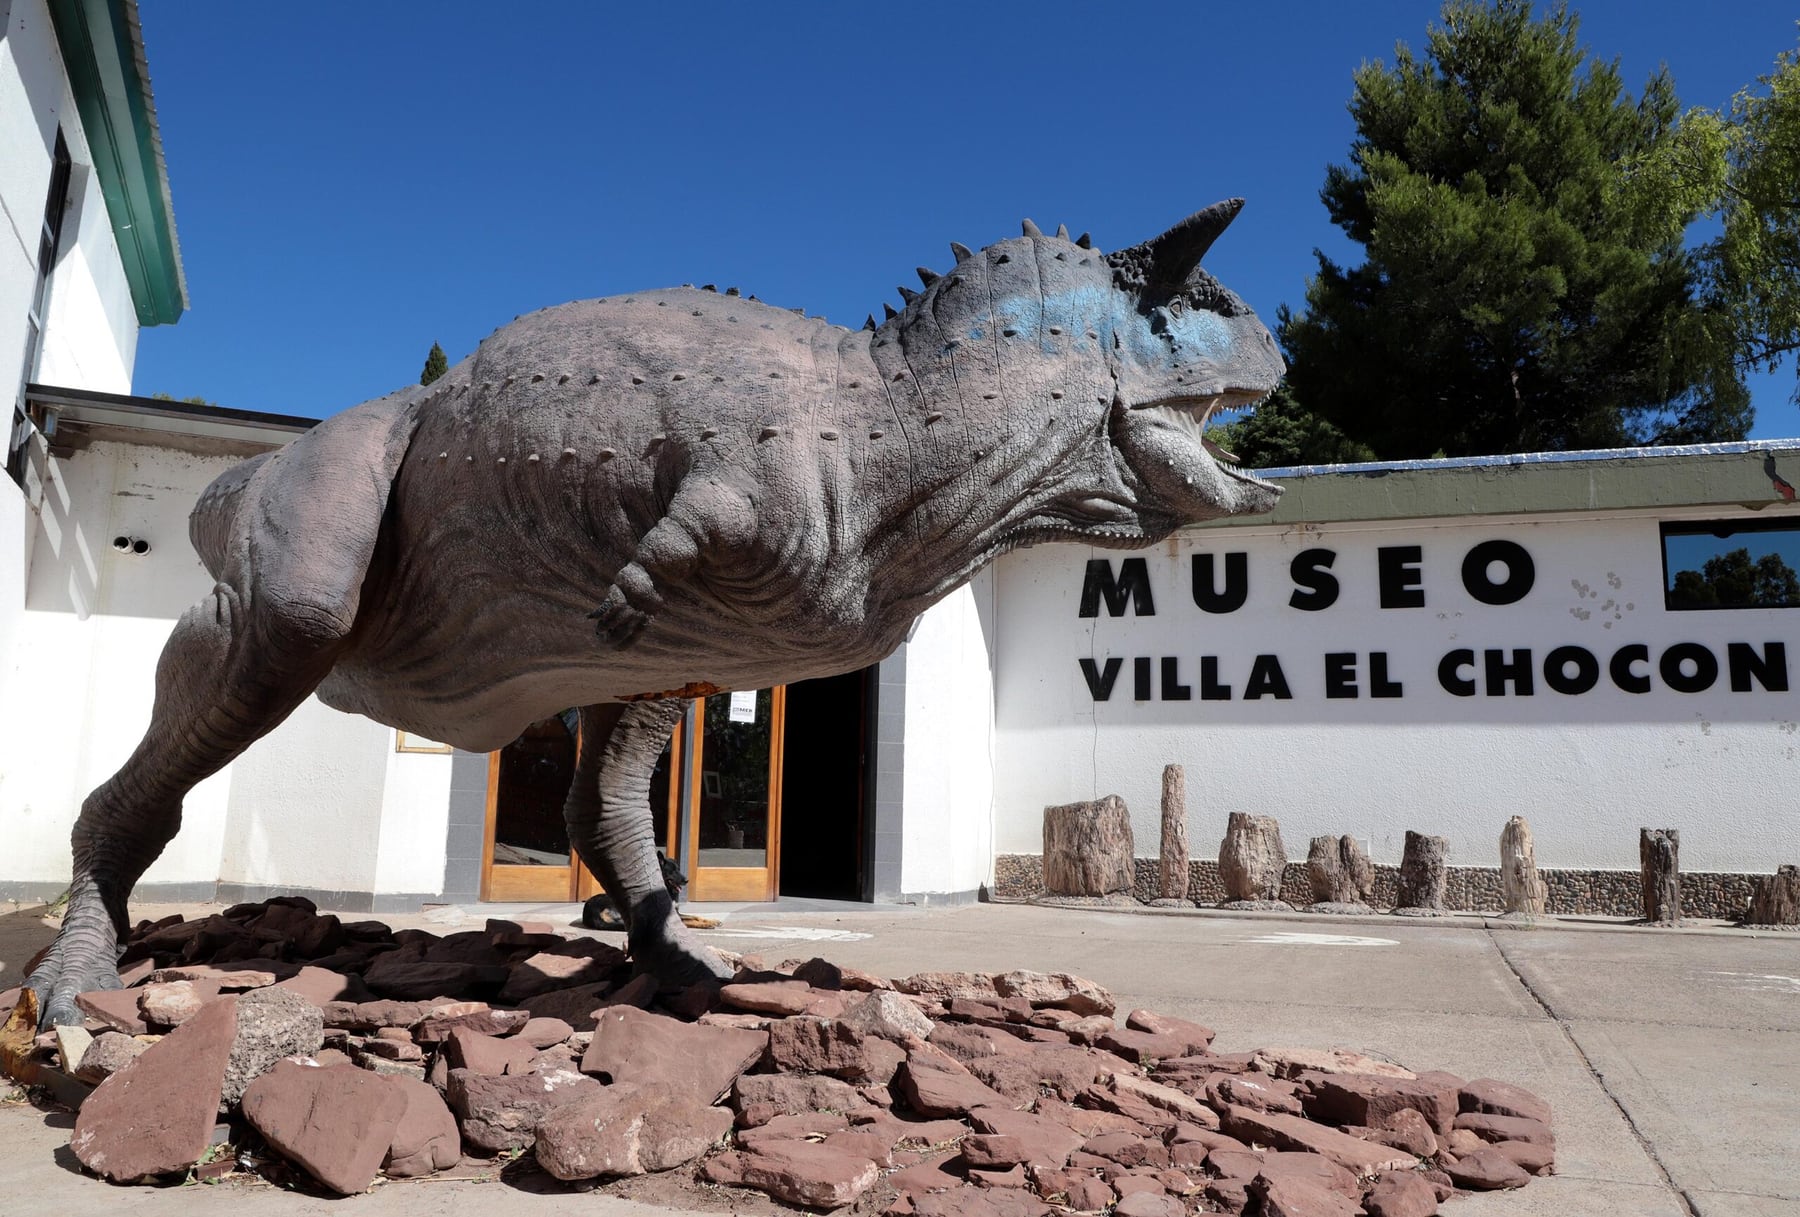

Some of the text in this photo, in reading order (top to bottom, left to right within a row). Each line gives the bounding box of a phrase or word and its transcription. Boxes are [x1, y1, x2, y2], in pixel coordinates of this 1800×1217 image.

[1079, 540, 1535, 618] MUSEO
[1079, 642, 1789, 701] VILLA EL CHOCON
